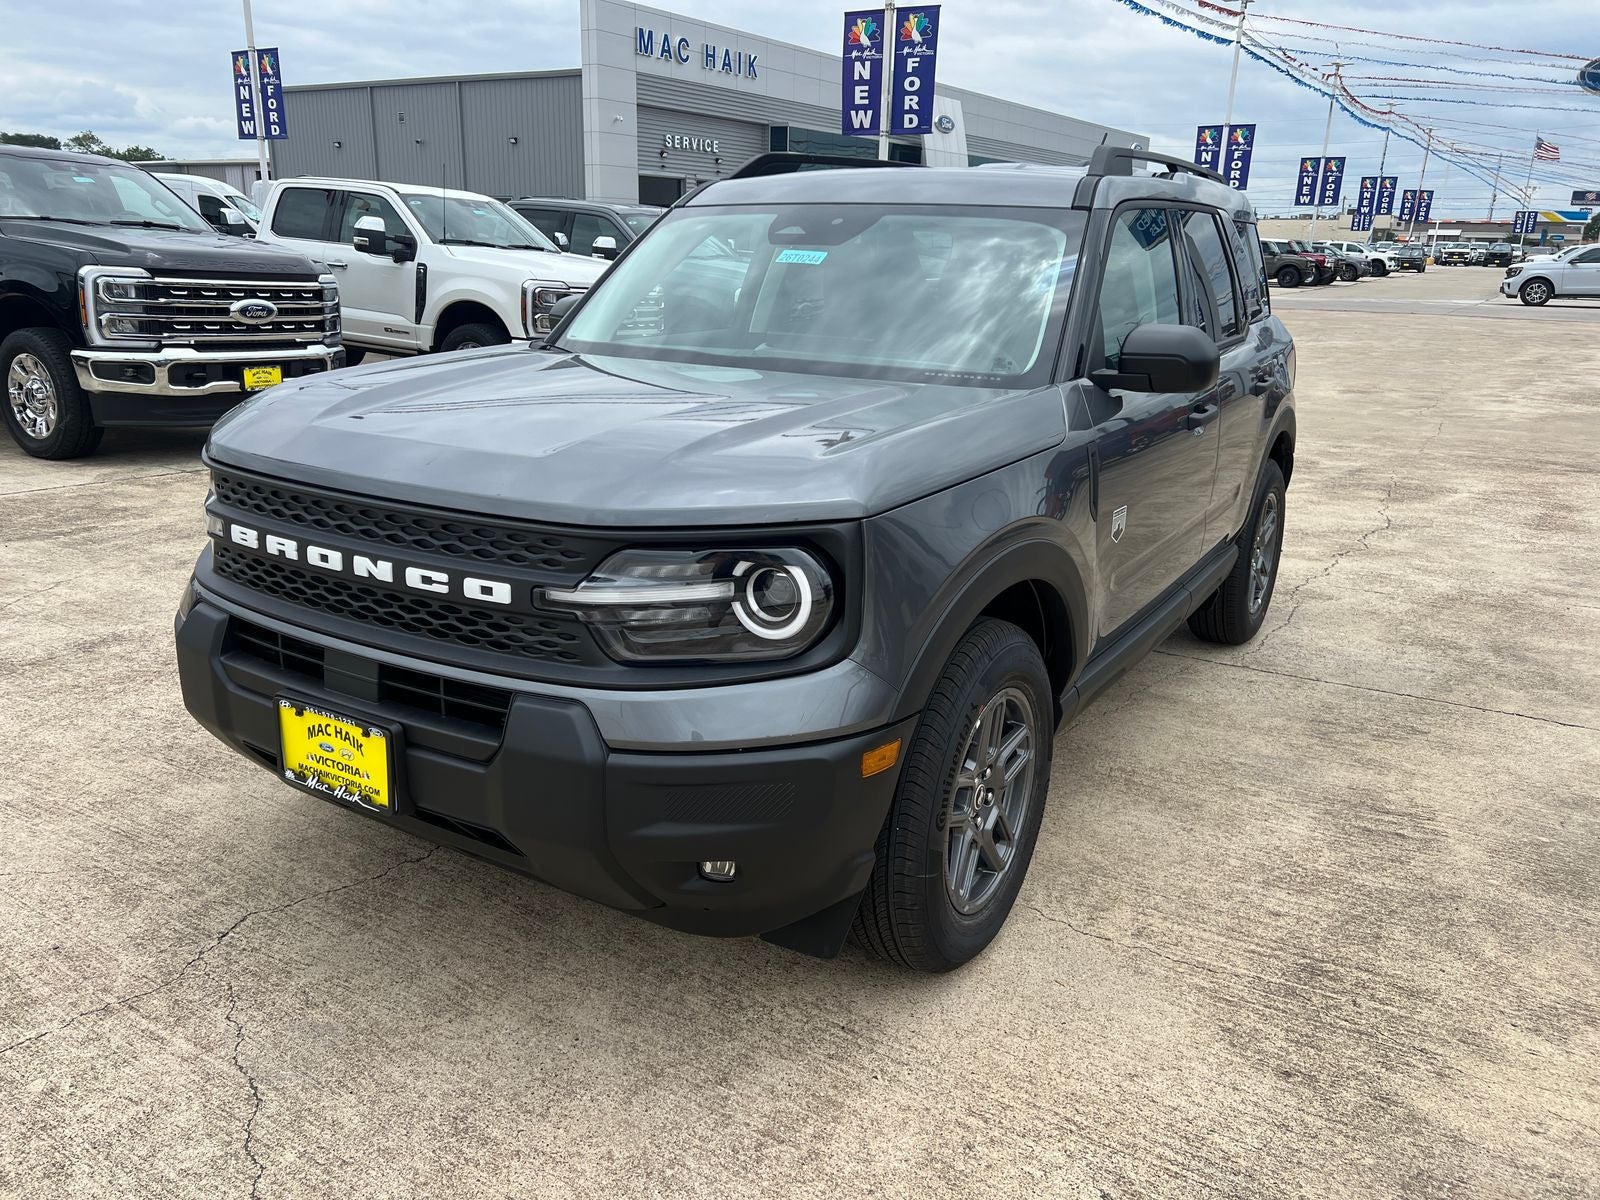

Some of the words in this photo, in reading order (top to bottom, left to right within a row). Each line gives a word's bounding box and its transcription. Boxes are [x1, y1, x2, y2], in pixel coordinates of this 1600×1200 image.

[636, 27, 690, 64] MAC
[704, 43, 759, 79] HAIK
[850, 61, 873, 129] NEW
[903, 57, 921, 128] FORD
[239, 86, 254, 135] NEW
[267, 85, 280, 135] FORD
[665, 134, 720, 153] SERVICE
[1229, 151, 1243, 188] FORD
[1299, 176, 1313, 204] NEW
[1324, 176, 1336, 204] FORD
[1360, 191, 1371, 214] NEW
[1380, 192, 1390, 214] FORD
[1402, 202, 1411, 220] NEW
[1418, 202, 1427, 221] FORD
[245, 305, 268, 318] Ford
[231, 524, 512, 605] BRONCO
[307, 723, 332, 740] MAC
[334, 725, 365, 757] HAIK
[298, 762, 381, 797] MACHAIKVICTORIA.COM
[313, 753, 362, 779] VICTORIA
[304, 775, 331, 795] Mac
